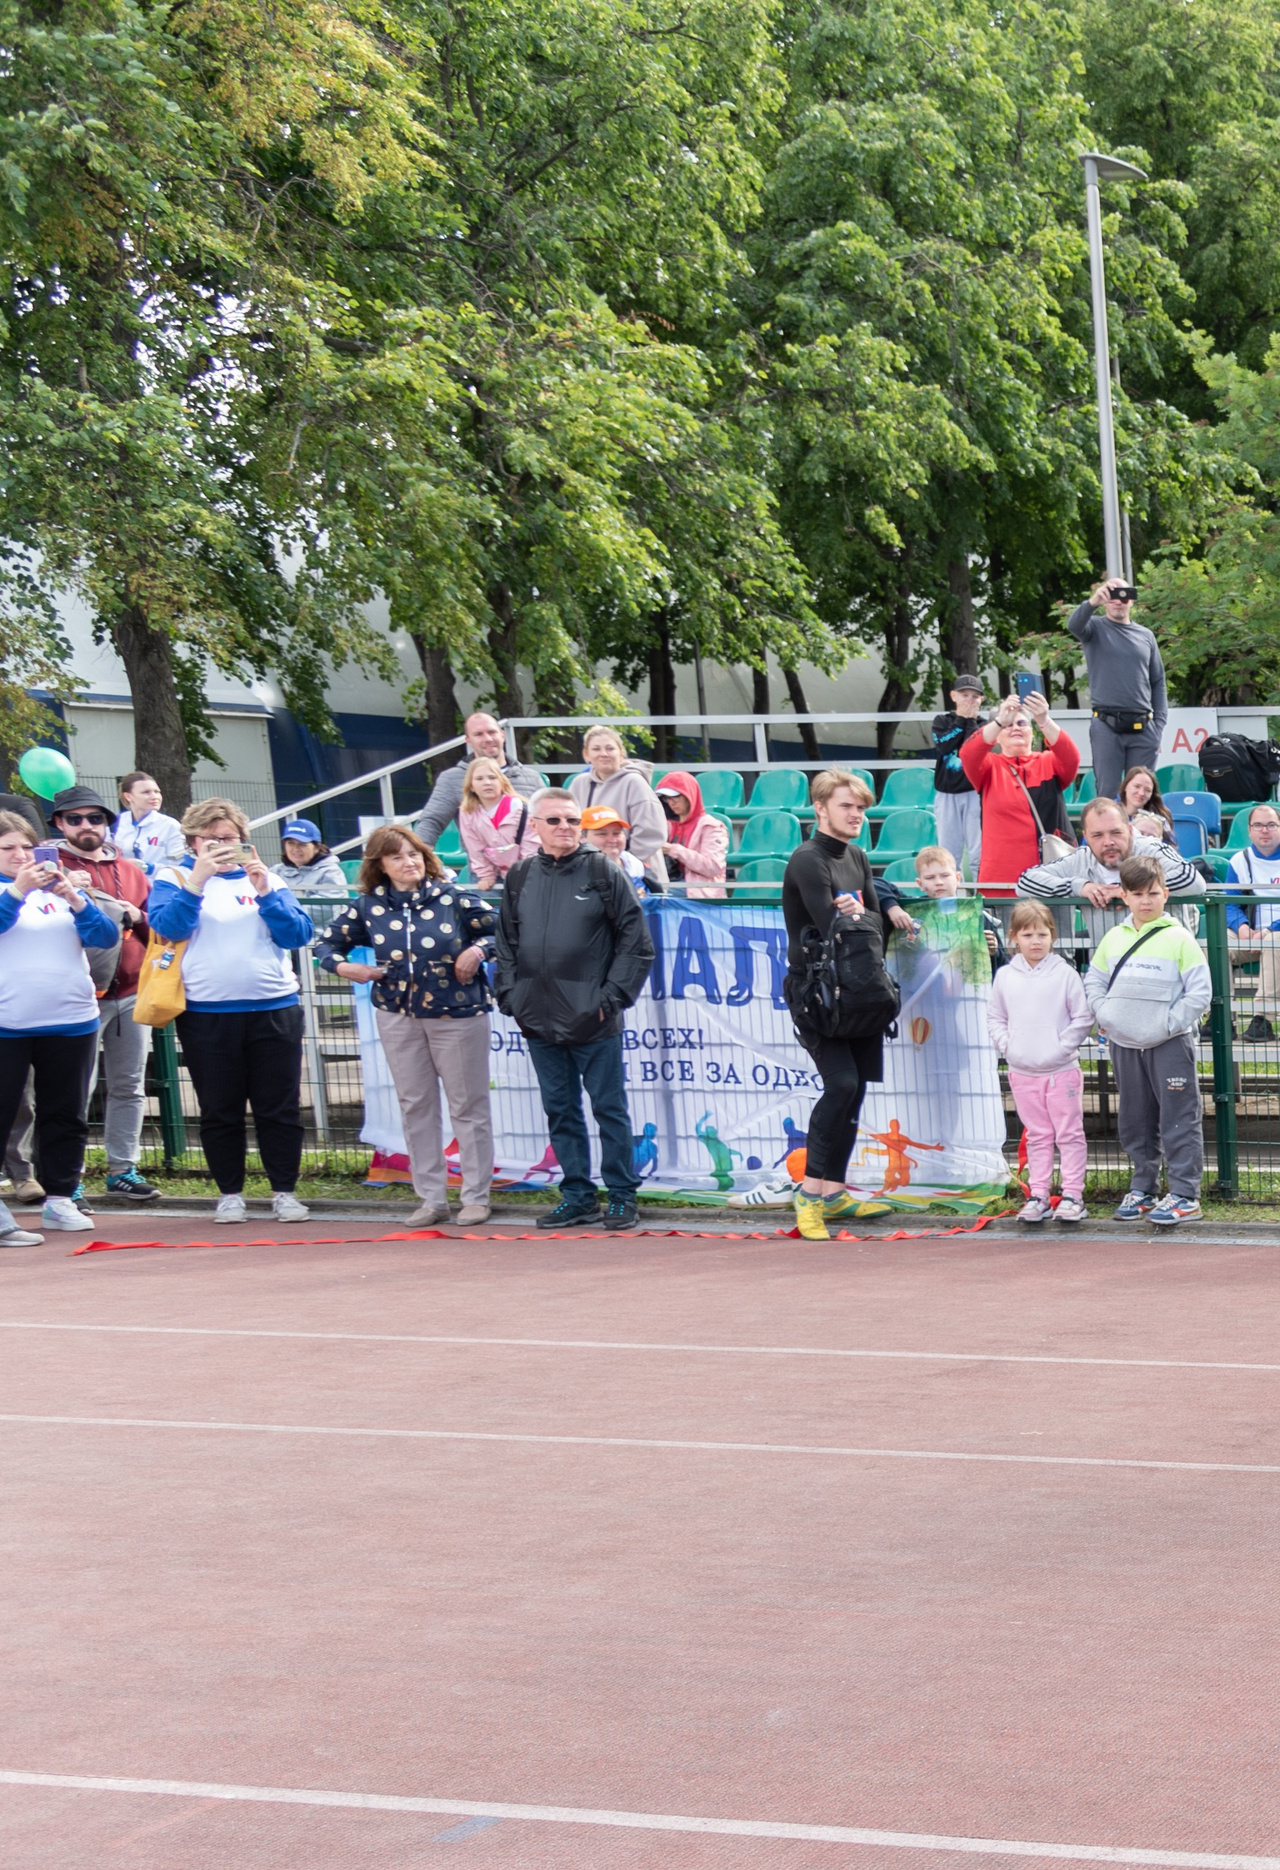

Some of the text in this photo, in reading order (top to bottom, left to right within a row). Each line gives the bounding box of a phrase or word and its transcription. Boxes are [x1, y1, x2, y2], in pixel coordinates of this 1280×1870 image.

[1171, 728, 1209, 753] A2
[622, 1028, 705, 1051] ВСЕХ!
[641, 1060, 695, 1083] ВСЕ
[706, 1062, 743, 1085] ЗА
